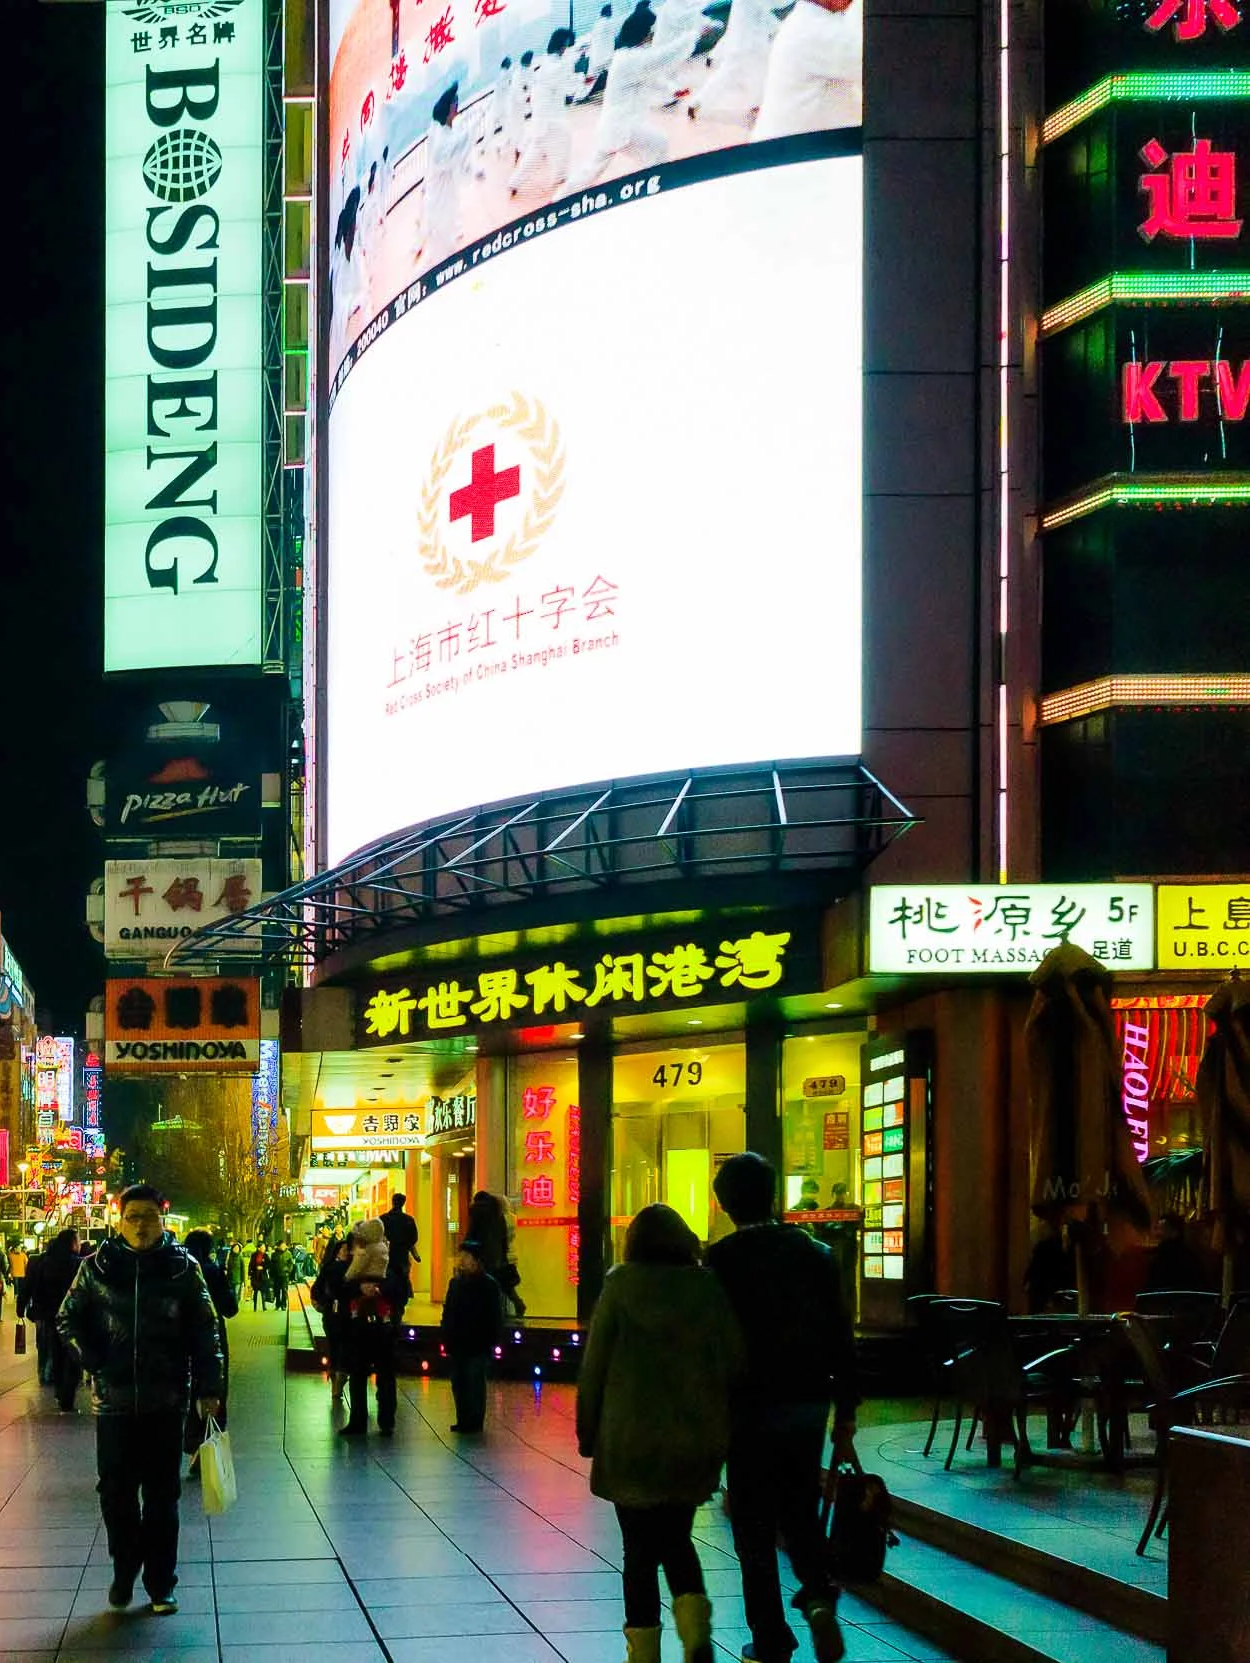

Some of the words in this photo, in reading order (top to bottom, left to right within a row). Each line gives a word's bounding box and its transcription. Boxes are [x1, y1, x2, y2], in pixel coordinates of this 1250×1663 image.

[1138, 138, 1243, 243] 迪
[356, 311, 389, 358] 200040
[1122, 360, 1250, 423] KTV
[386, 575, 619, 688] 上海市红十字会
[425, 676, 459, 699] Society
[463, 669, 473, 684] of
[476, 661, 507, 680] China
[511, 647, 567, 669] Shanghai
[572, 631, 619, 655] Branch
[197, 782, 251, 807] Hut
[888, 895, 1087, 942] 桃源乡
[1107, 896, 1139, 924] 5F
[907, 948, 965, 963] FOOT
[1093, 938, 1134, 961] 足道
[365, 931, 791, 1037] 新世界休闲港湾
[653, 1061, 704, 1088] 479
[809, 1079, 838, 1089] 479
[523, 1087, 556, 1208] 好乐迪
